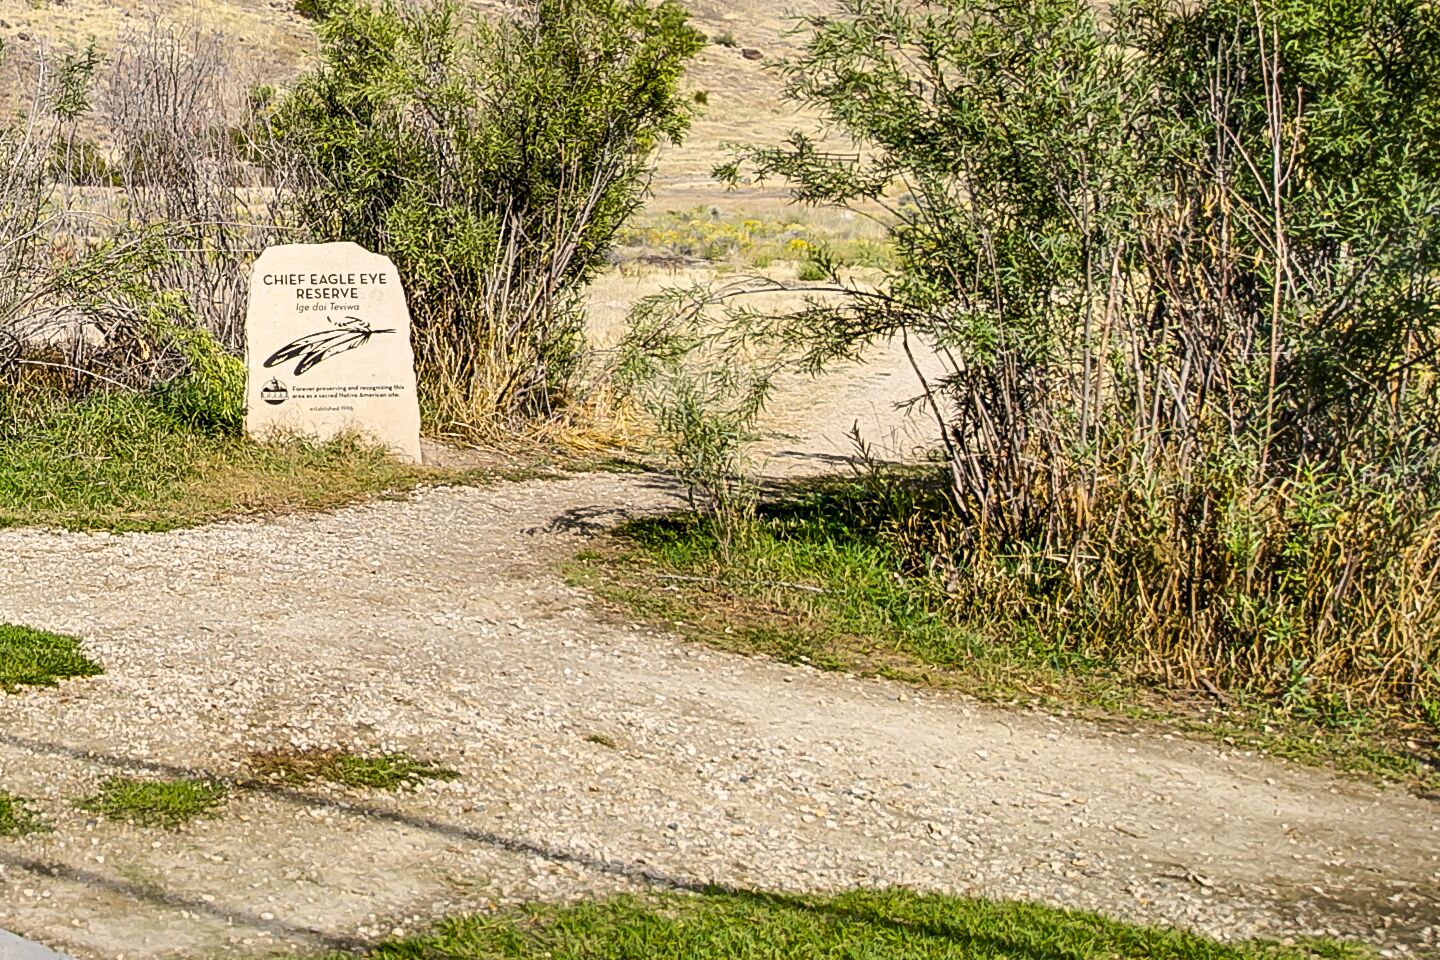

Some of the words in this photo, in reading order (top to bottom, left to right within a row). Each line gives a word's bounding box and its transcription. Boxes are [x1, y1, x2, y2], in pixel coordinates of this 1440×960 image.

[264, 274, 306, 285] CHIEF
[310, 274, 355, 285] EAGLE
[360, 273, 387, 284] EYE
[296, 288, 358, 299] RESERVE
[312, 302, 327, 311] dai
[330, 302, 360, 311] Teviwa
